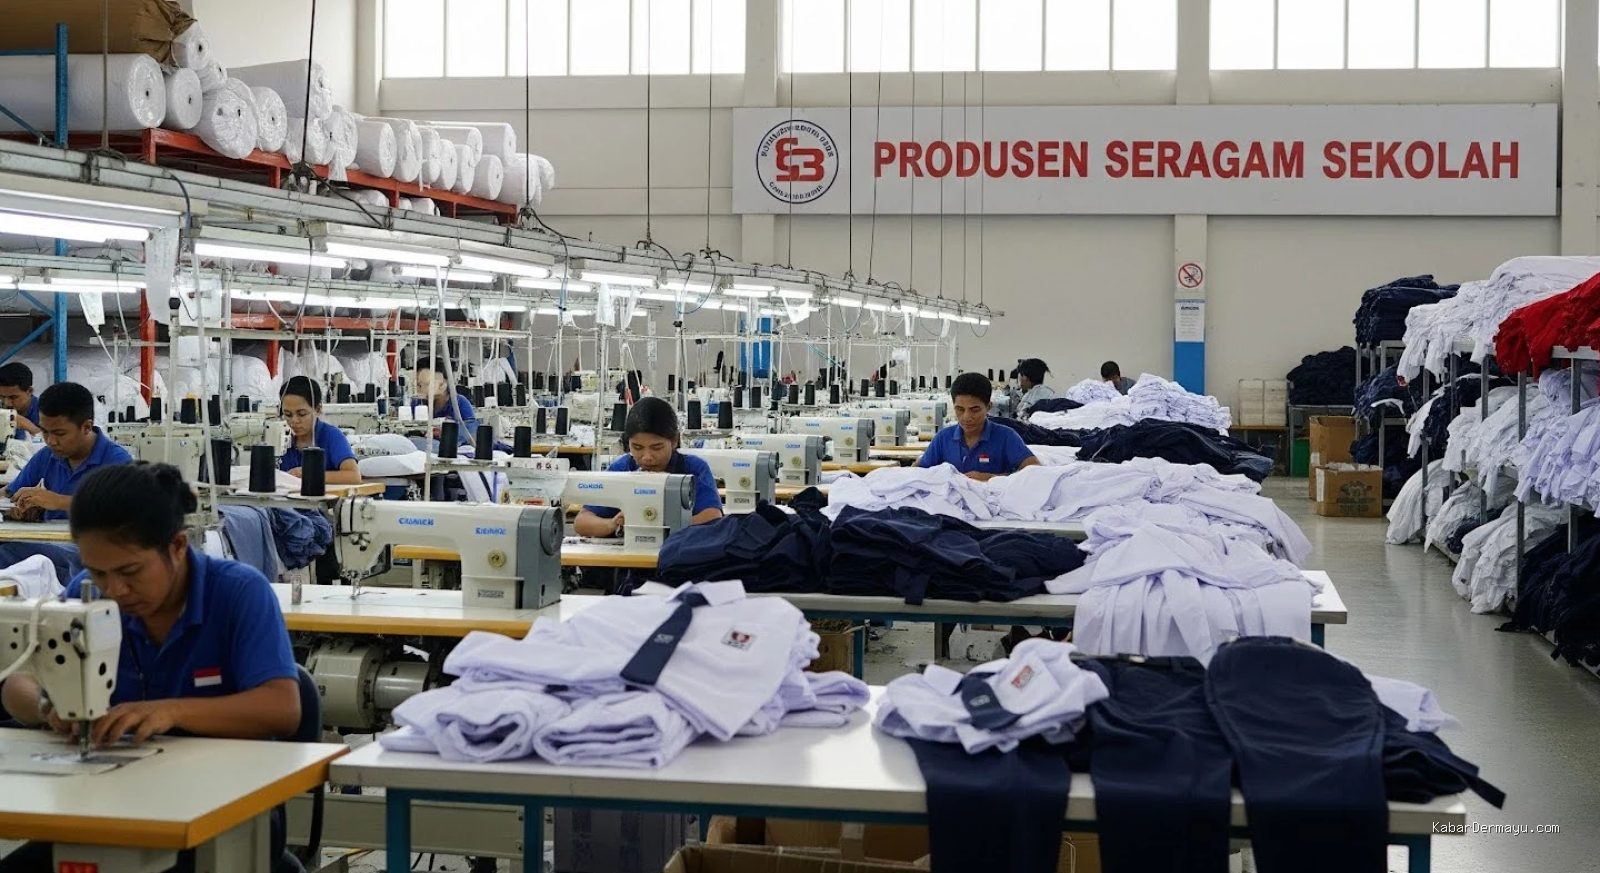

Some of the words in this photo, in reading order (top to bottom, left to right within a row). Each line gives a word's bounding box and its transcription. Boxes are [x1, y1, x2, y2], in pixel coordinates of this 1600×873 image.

[874, 141, 1089, 178] PRODUSEN
[1105, 140, 1305, 179] SERAGAM
[1323, 140, 1520, 179] SEKOLAH
